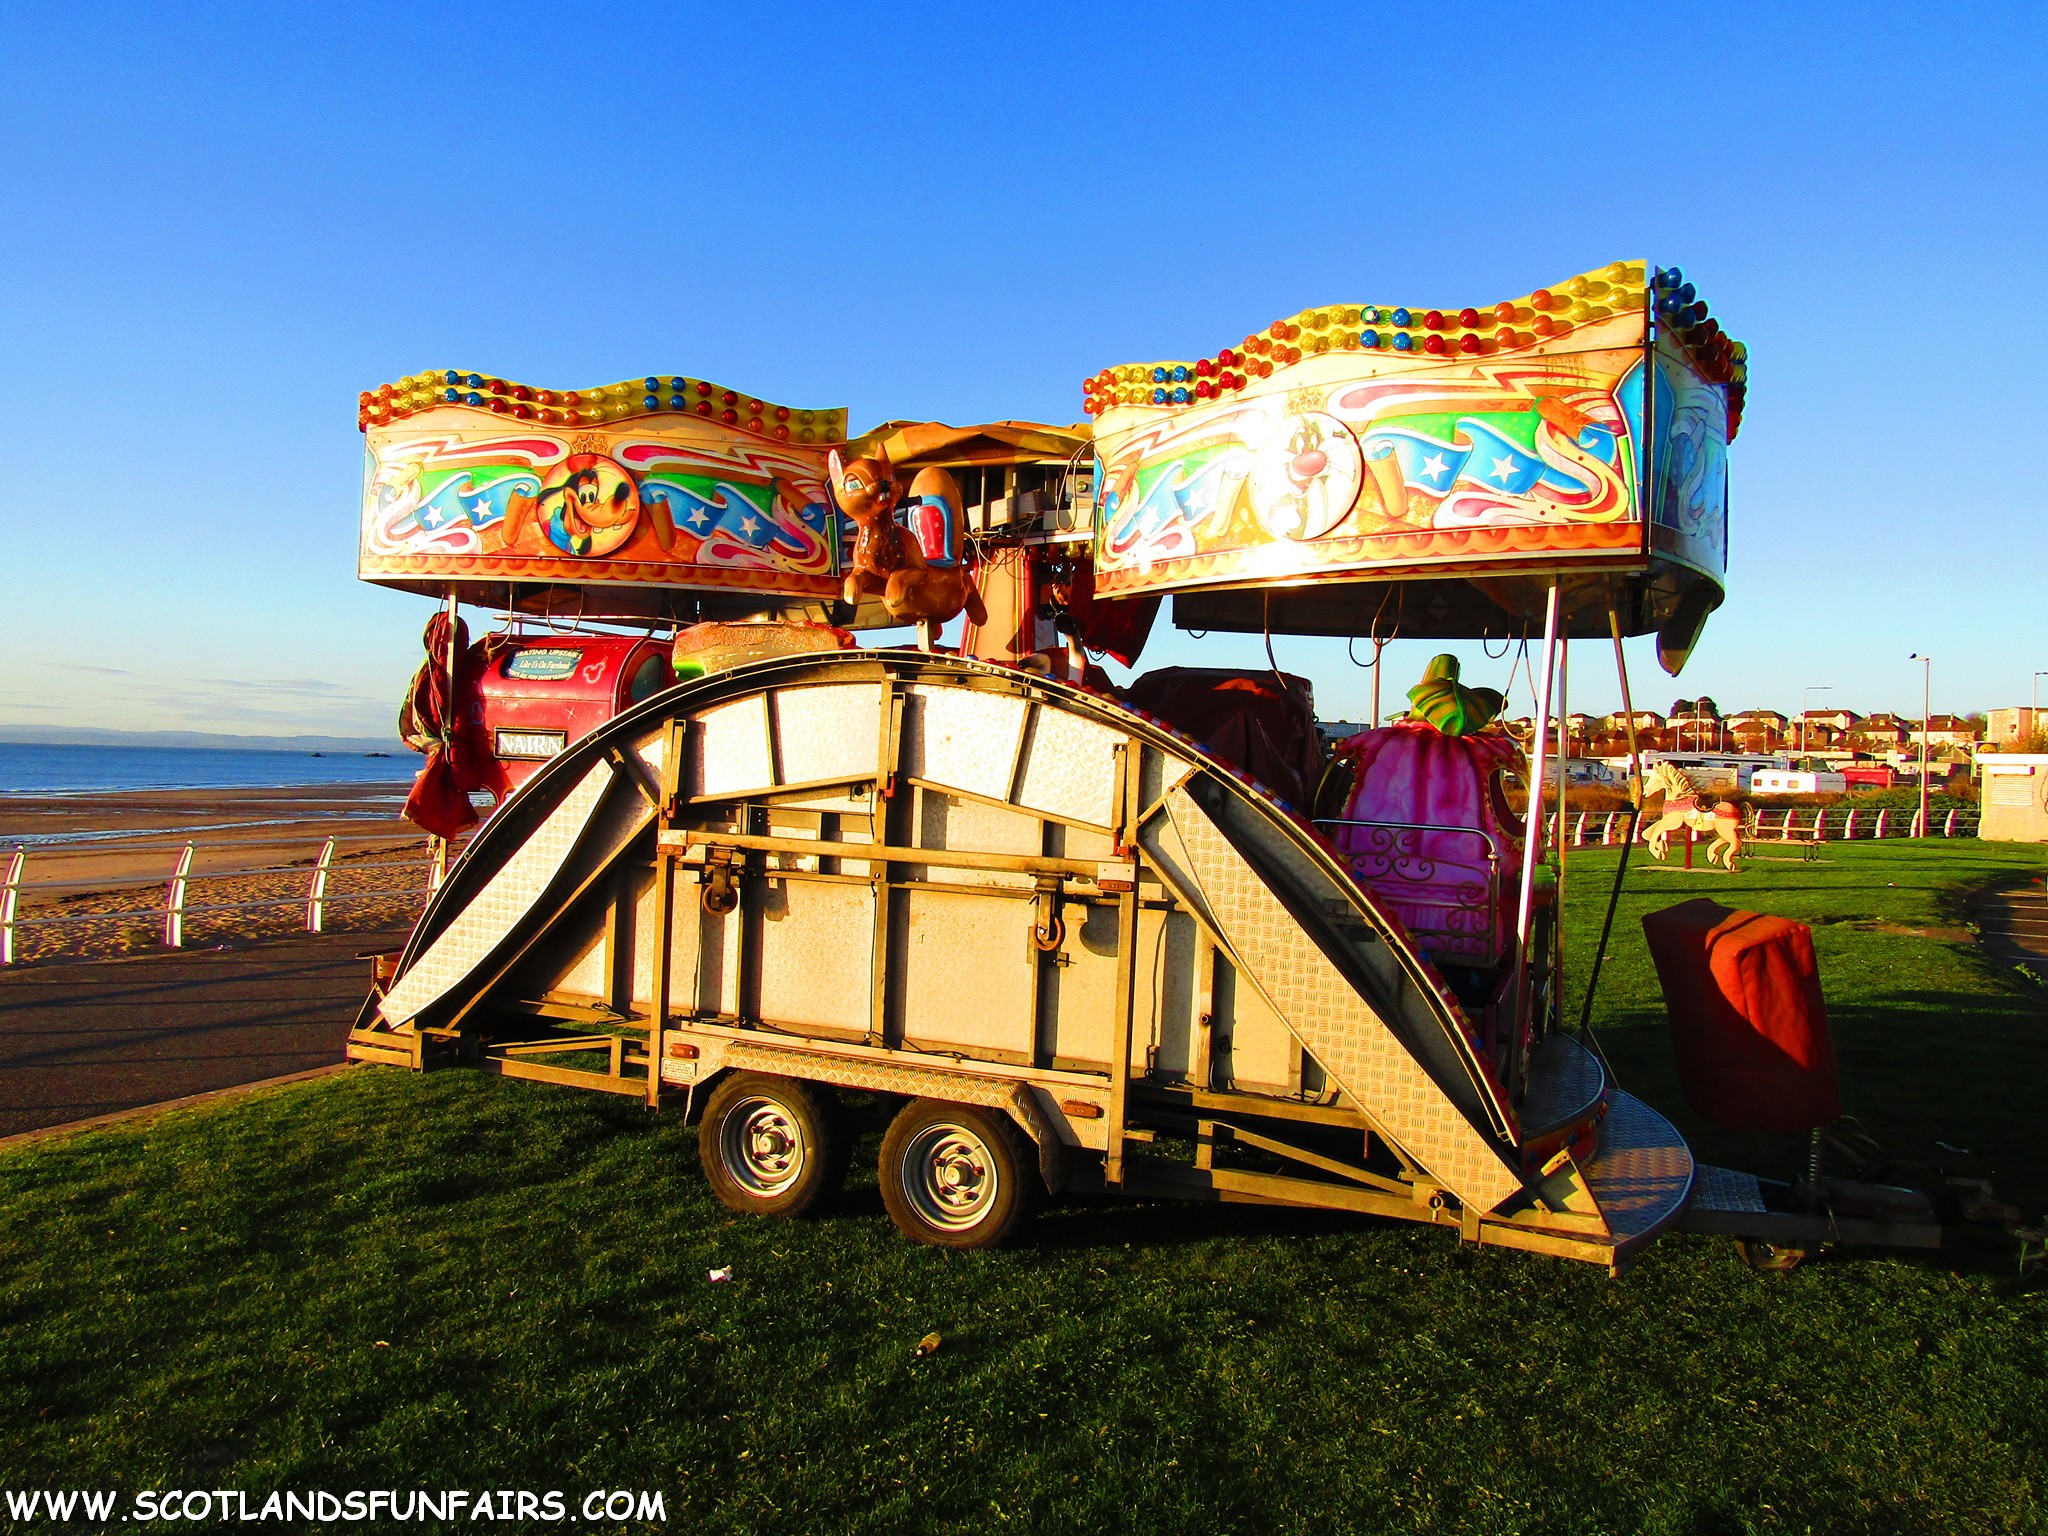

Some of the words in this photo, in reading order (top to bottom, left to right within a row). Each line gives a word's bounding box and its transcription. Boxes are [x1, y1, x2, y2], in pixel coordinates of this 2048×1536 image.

[519, 660, 531, 668] Like
[538, 661, 547, 669] On
[547, 661, 571, 670] Facebook
[498, 733, 563, 755] NAIRN
